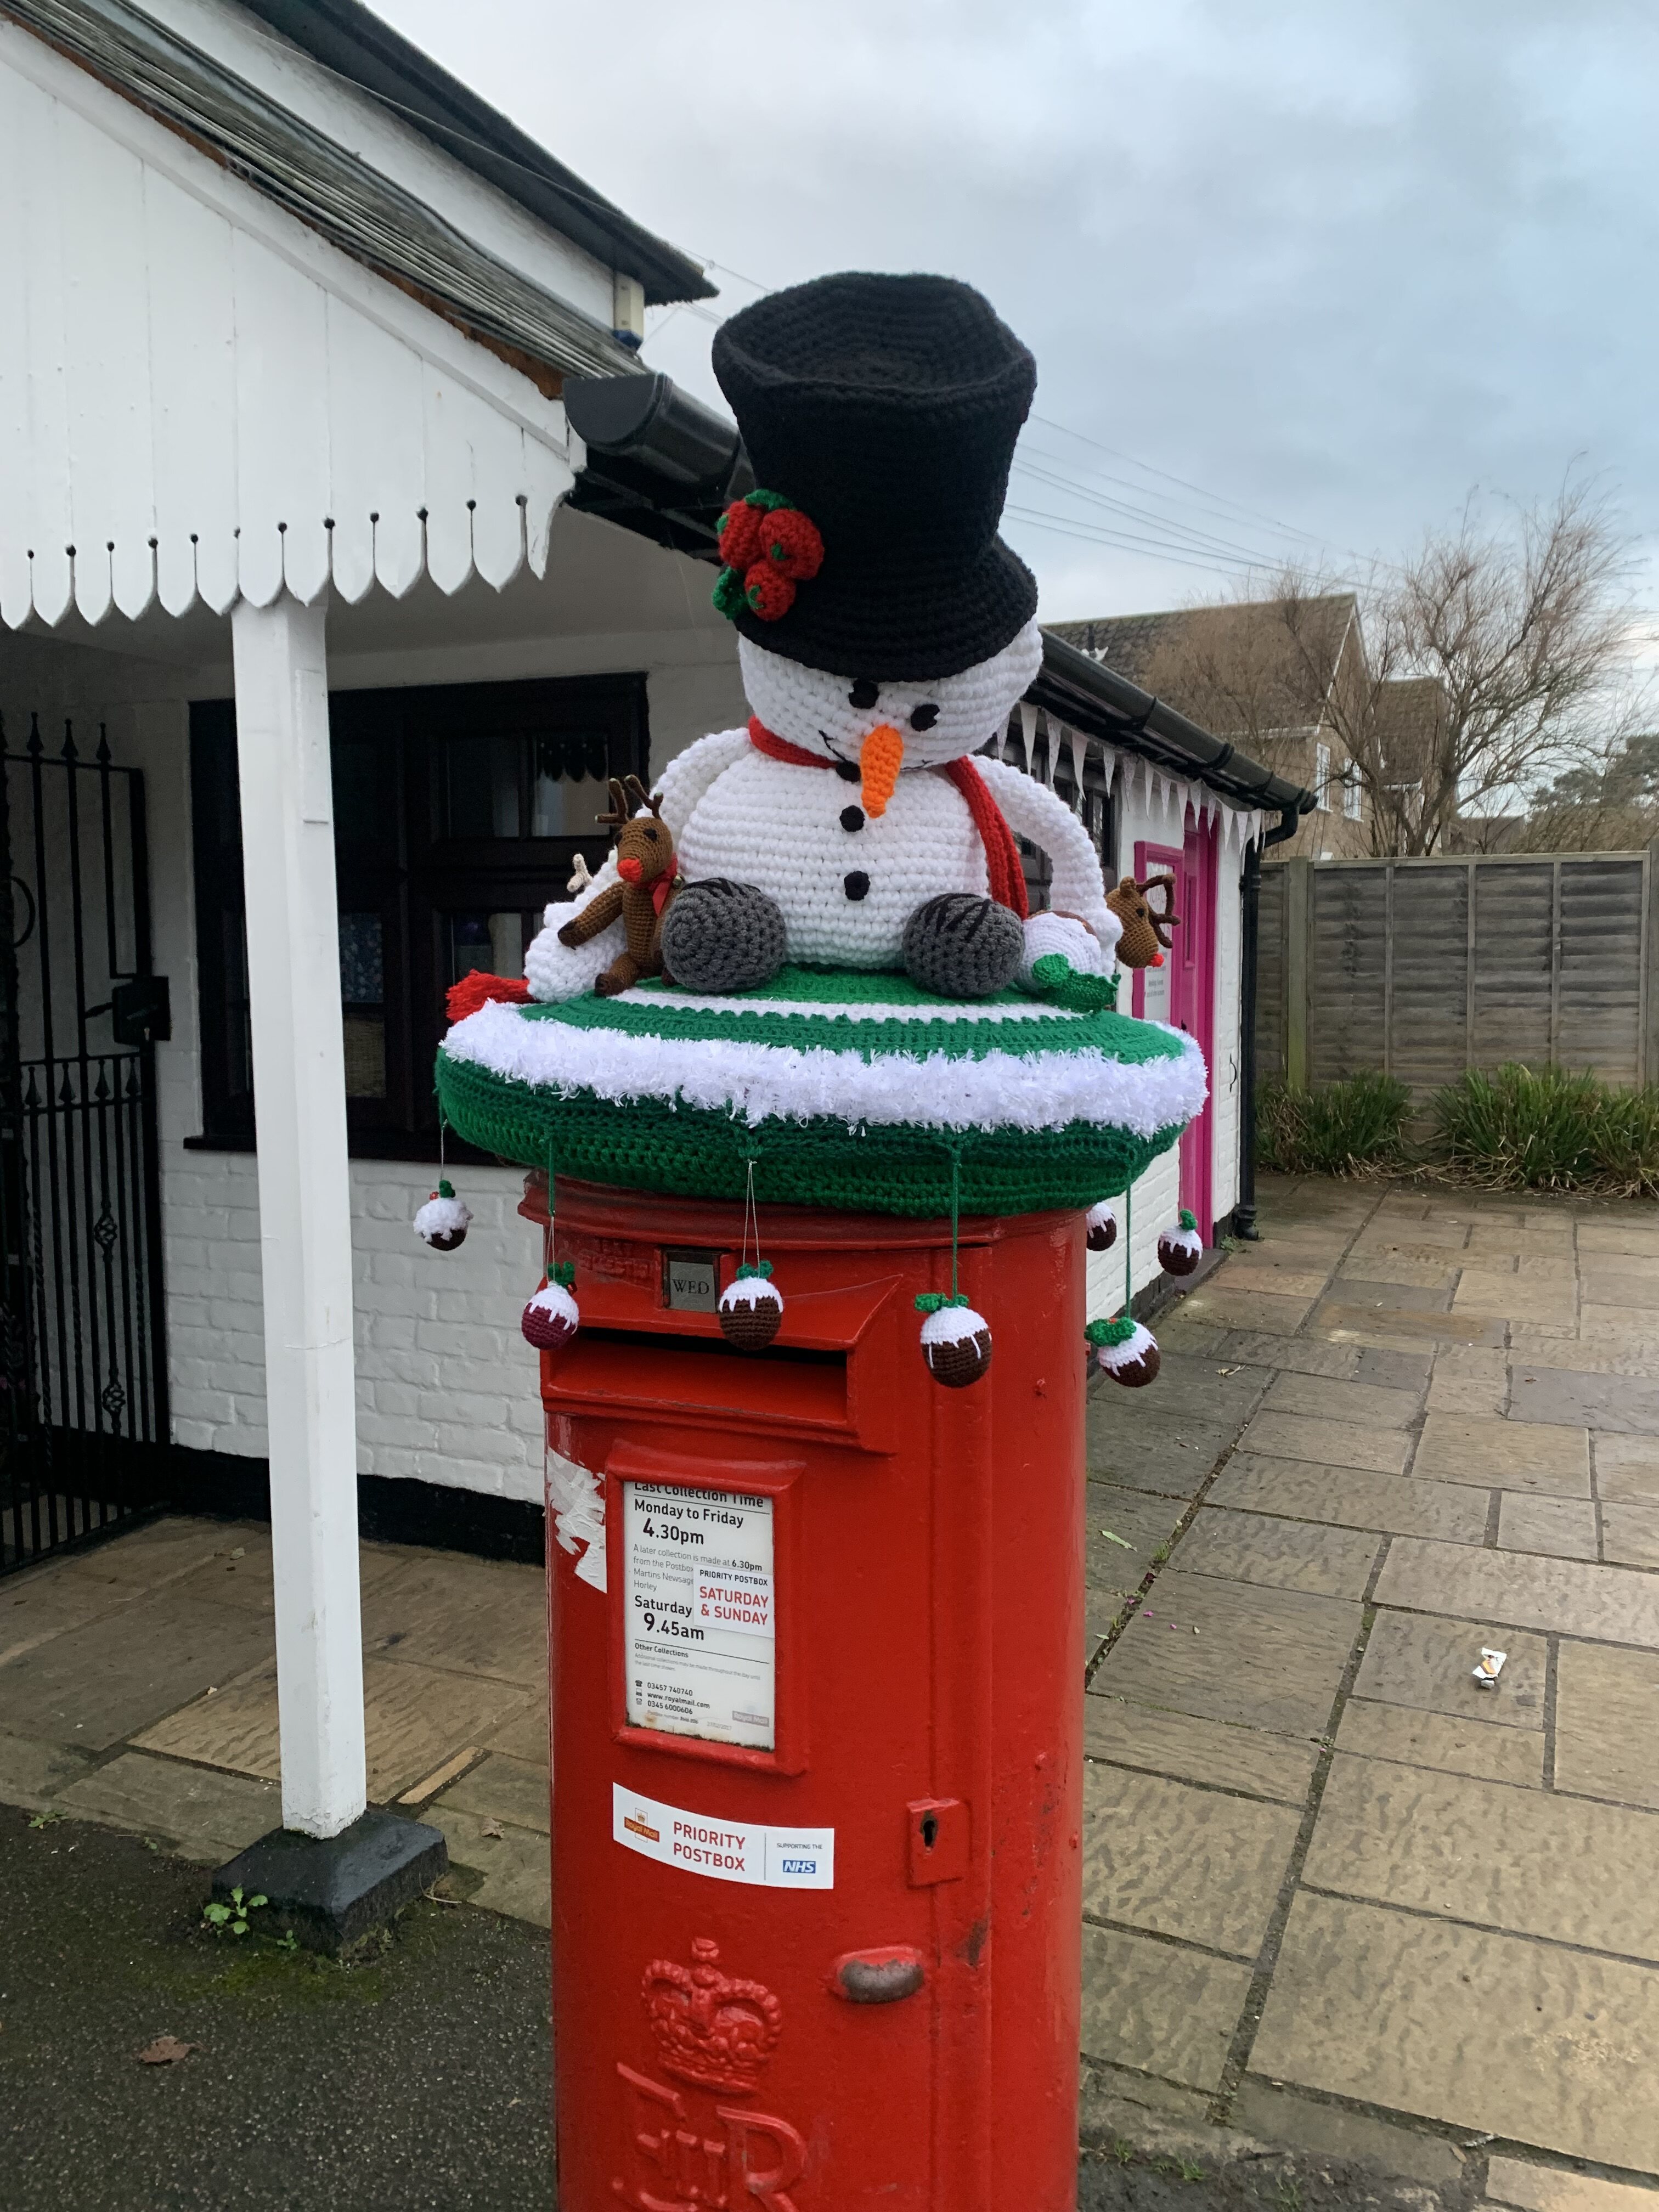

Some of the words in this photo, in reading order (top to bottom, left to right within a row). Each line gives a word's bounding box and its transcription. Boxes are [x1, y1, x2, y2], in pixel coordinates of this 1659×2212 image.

[672, 1279, 709, 1294] WED
[635, 1499, 684, 1519] Monday
[686, 1508, 699, 1519] to
[703, 1509, 743, 1528] Friday
[643, 1517, 704, 1545] 4.30pm
[633, 1544, 639, 1552] A
[640, 1545, 656, 1554] later
[658, 1549, 692, 1560] collection
[693, 1553, 699, 1561] is
[701, 1556, 721, 1565] made
[732, 1560, 763, 1571] 6.30pm
[633, 1556, 651, 1566] from
[652, 1560, 664, 1568] the
[634, 1568, 661, 1579] Martins
[699, 1569, 732, 1581] PRIORITY
[735, 1575, 768, 1586] POSTBOX
[634, 1580, 657, 1592] Horley
[699, 1586, 769, 1608] SATURDAY
[635, 1595, 692, 1618] Saturday
[701, 1604, 709, 1616] &
[714, 1606, 768, 1625] SUNDAY
[644, 1612, 704, 1640] 9.45am
[635, 1643, 652, 1651] Other
[654, 1646, 689, 1658] Collections
[647, 1682, 667, 1691] 03457
[669, 1686, 693, 1696] 740740
[647, 1692, 710, 1709] www.royalmail.com
[647, 1700, 663, 1709] 0345
[734, 1712, 753, 1723] Royal
[625, 1818, 642, 1832] Royal
[644, 1827, 658, 1839] Mail
[674, 1821, 746, 1850] PRIORITY
[674, 1842, 746, 1872] POSTBOX
[783, 1860, 815, 1873] NHS
